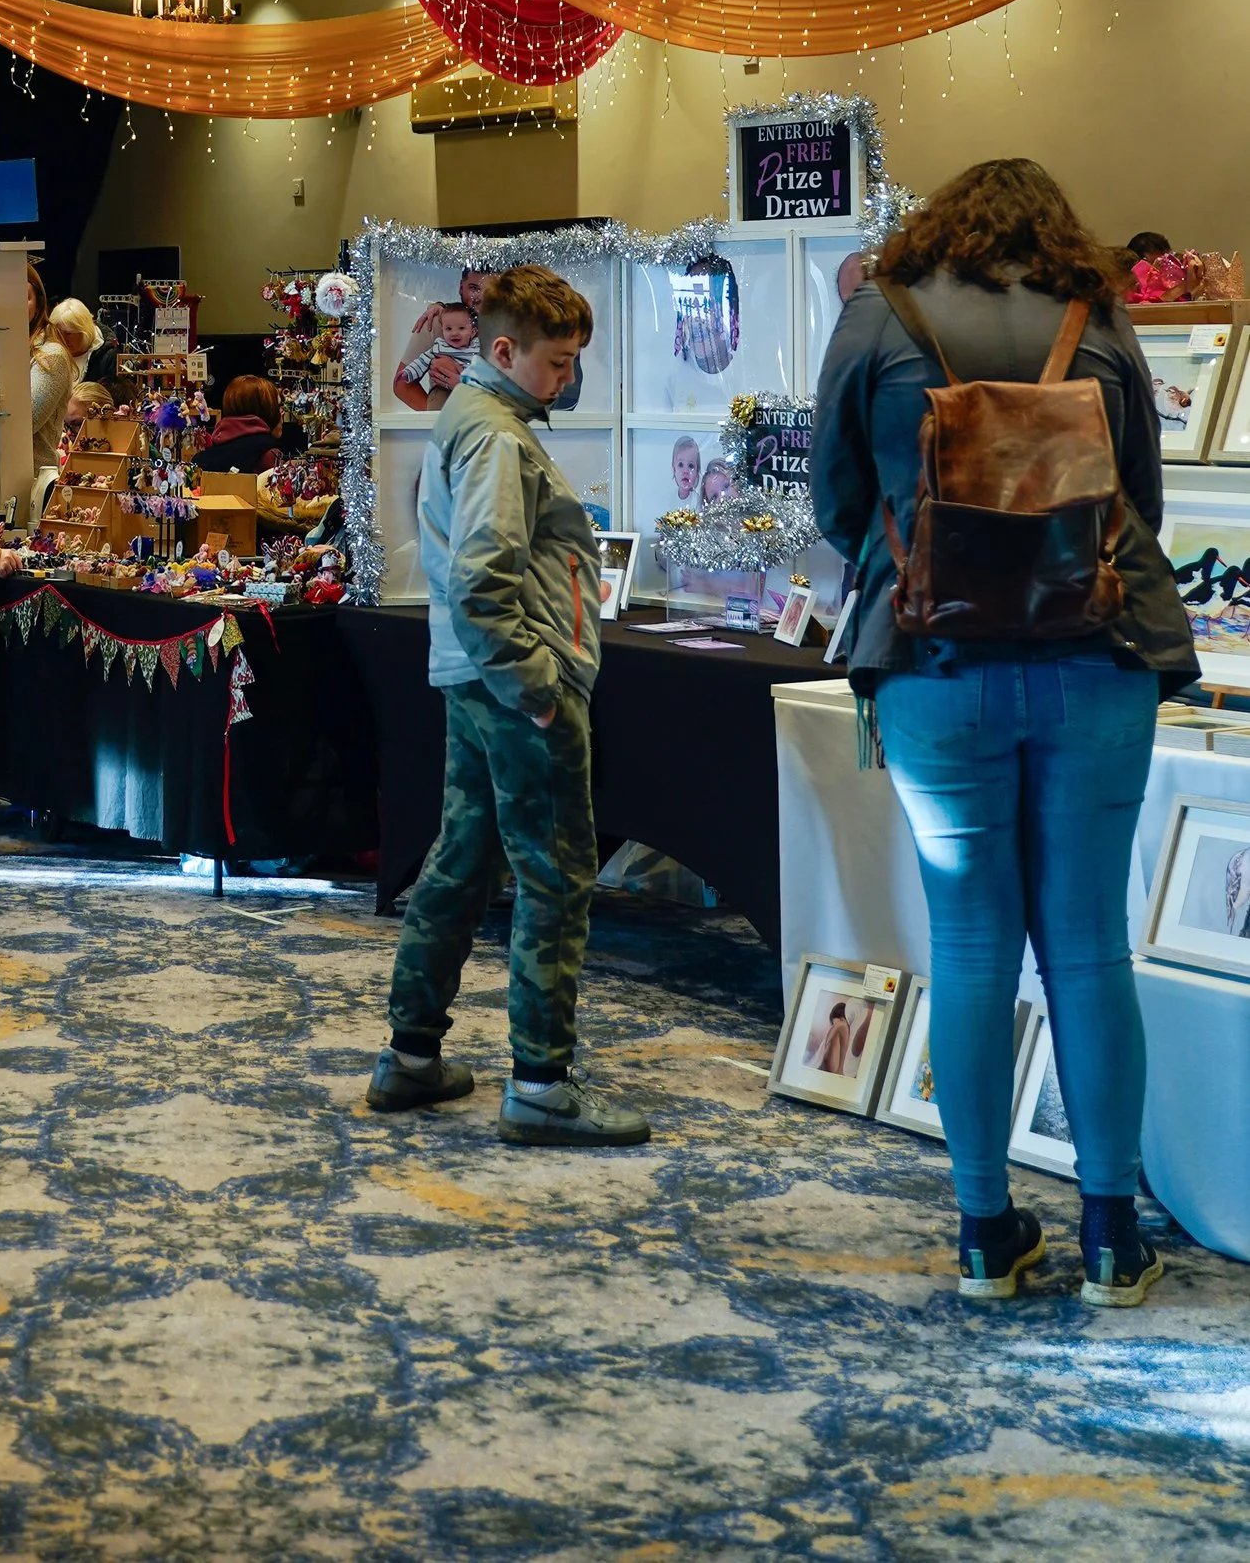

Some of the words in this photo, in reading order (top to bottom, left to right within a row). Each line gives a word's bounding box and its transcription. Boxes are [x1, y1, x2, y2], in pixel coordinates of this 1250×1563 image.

[758, 124, 802, 142] ENTER
[805, 122, 835, 138] OUR
[786, 141, 832, 164] FREE
[756, 152, 822, 197] Prize
[755, 411, 795, 427] ENTER
[798, 412, 814, 427] OU
[781, 429, 812, 448] FRE
